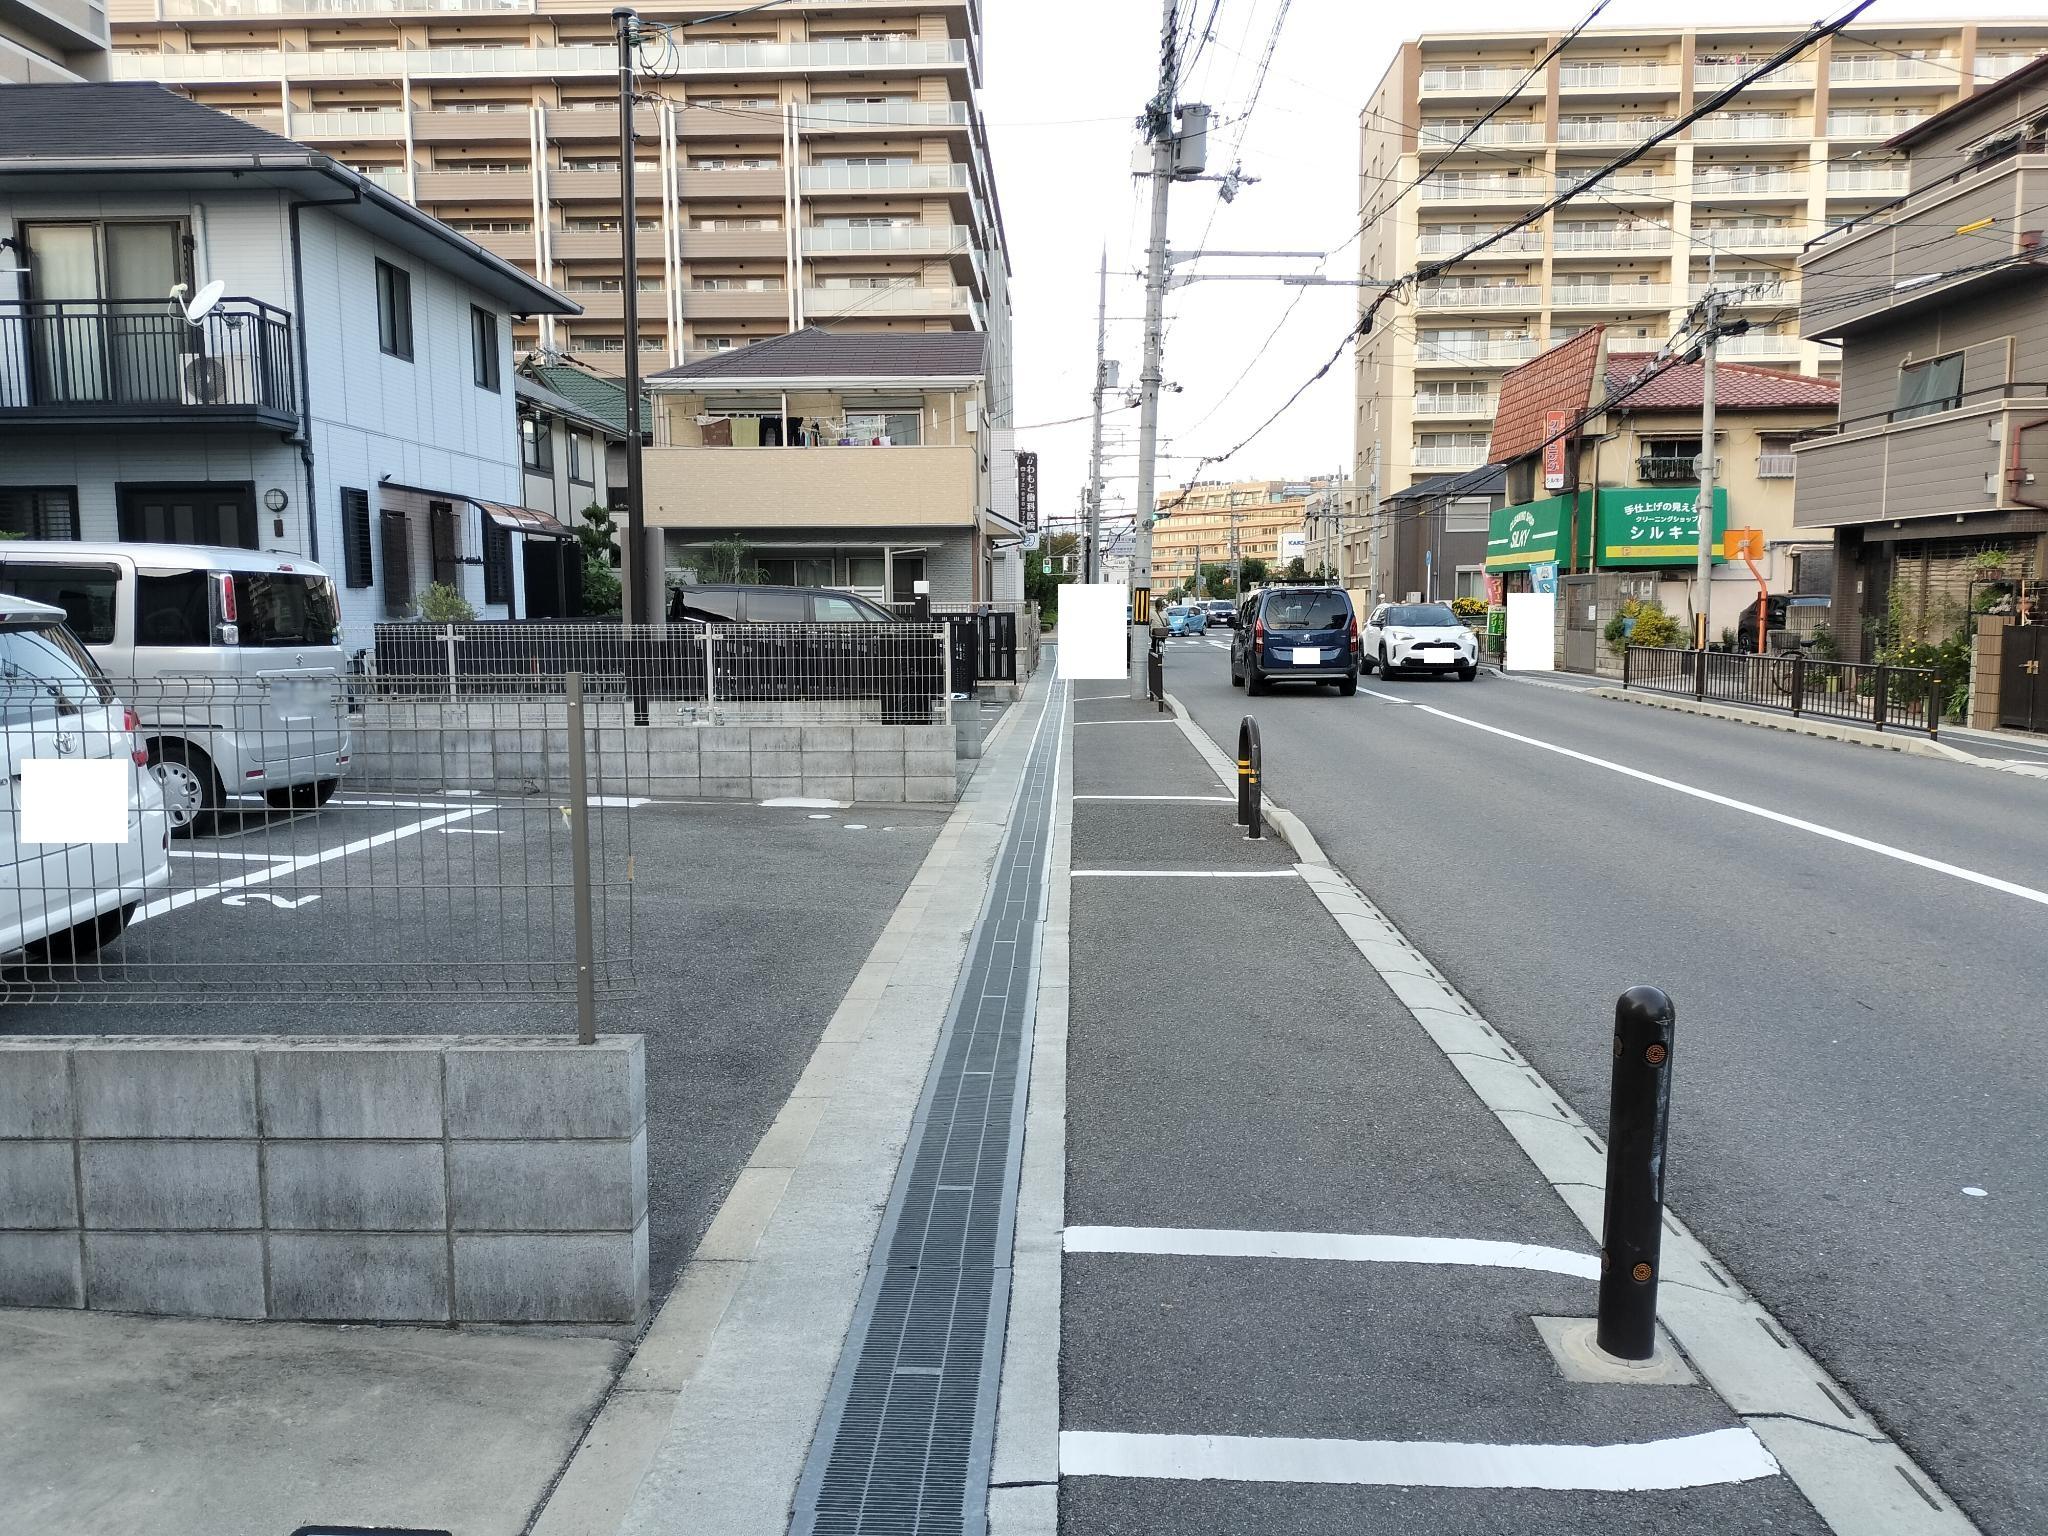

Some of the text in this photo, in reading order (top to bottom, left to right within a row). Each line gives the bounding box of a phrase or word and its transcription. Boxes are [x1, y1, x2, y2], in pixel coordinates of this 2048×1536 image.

[1026, 456, 1035, 530] かわもと歯科医院
[1511, 529, 1530, 548] SILKY
[1630, 526, 1700, 540] シルキー
